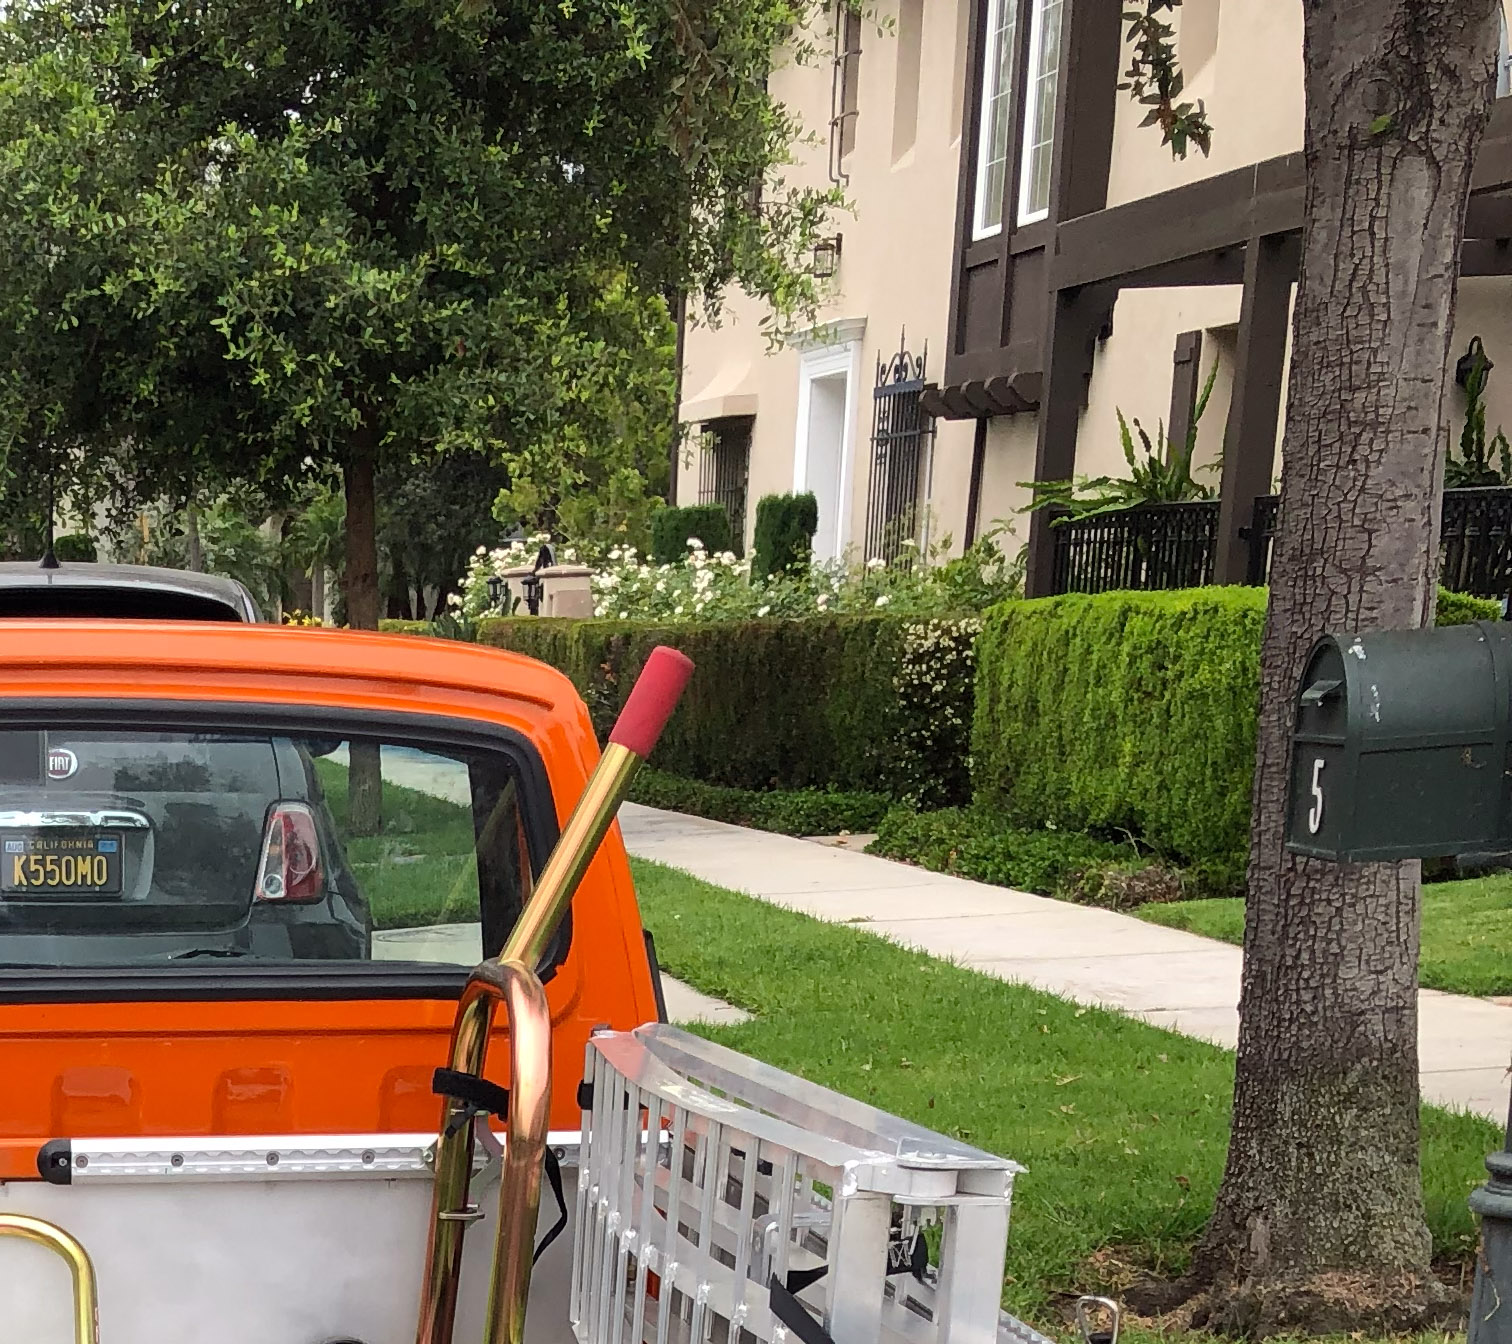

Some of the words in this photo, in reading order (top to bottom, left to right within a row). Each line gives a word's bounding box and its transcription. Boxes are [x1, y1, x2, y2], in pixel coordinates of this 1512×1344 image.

[50, 756, 70, 771] FIAT
[1309, 759, 1325, 834] 5
[29, 840, 94, 850] CALIFORNIA
